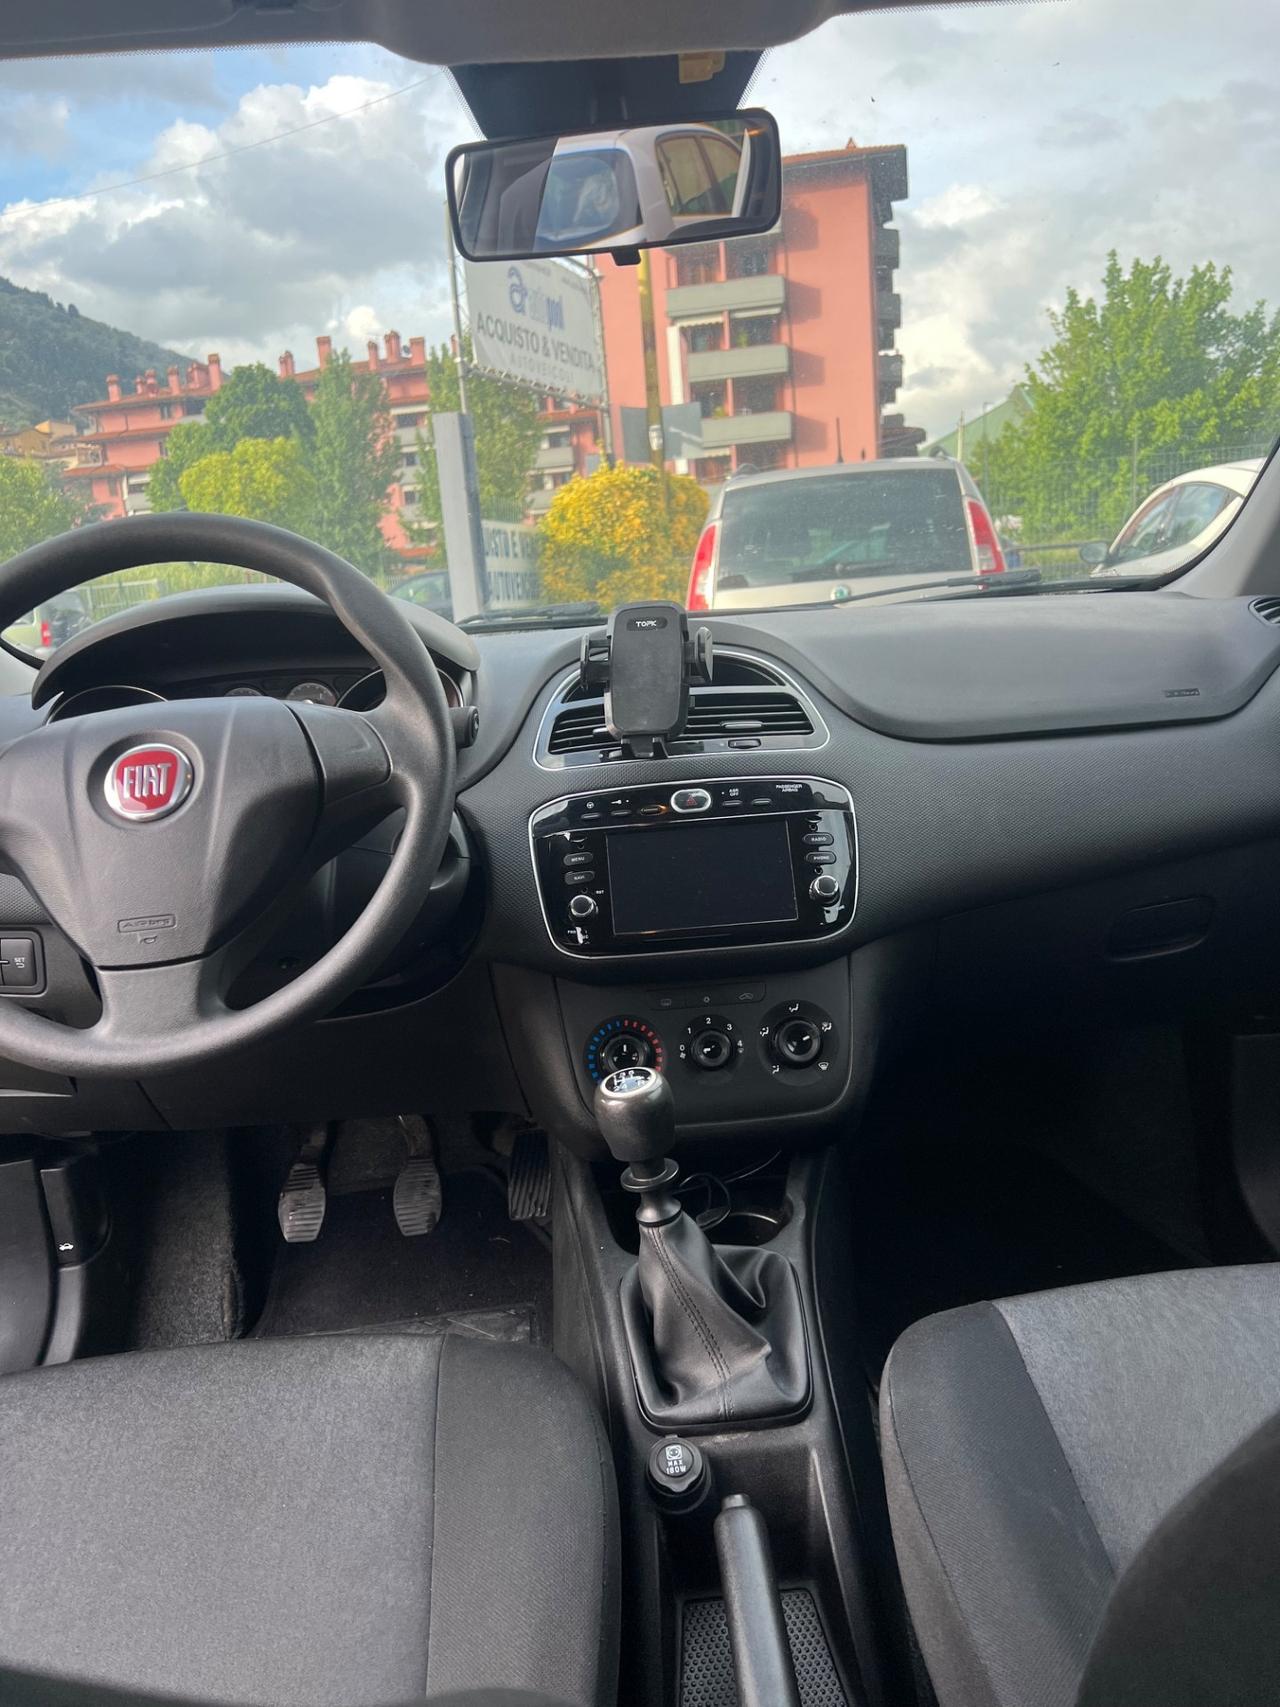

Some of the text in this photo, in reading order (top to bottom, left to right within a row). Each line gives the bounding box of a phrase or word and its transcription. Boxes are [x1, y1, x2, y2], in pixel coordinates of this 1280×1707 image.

[477, 312, 595, 369] ACQUISTO & VENDITA
[635, 620, 657, 628] TOPK
[123, 763, 172, 799] FIAT
